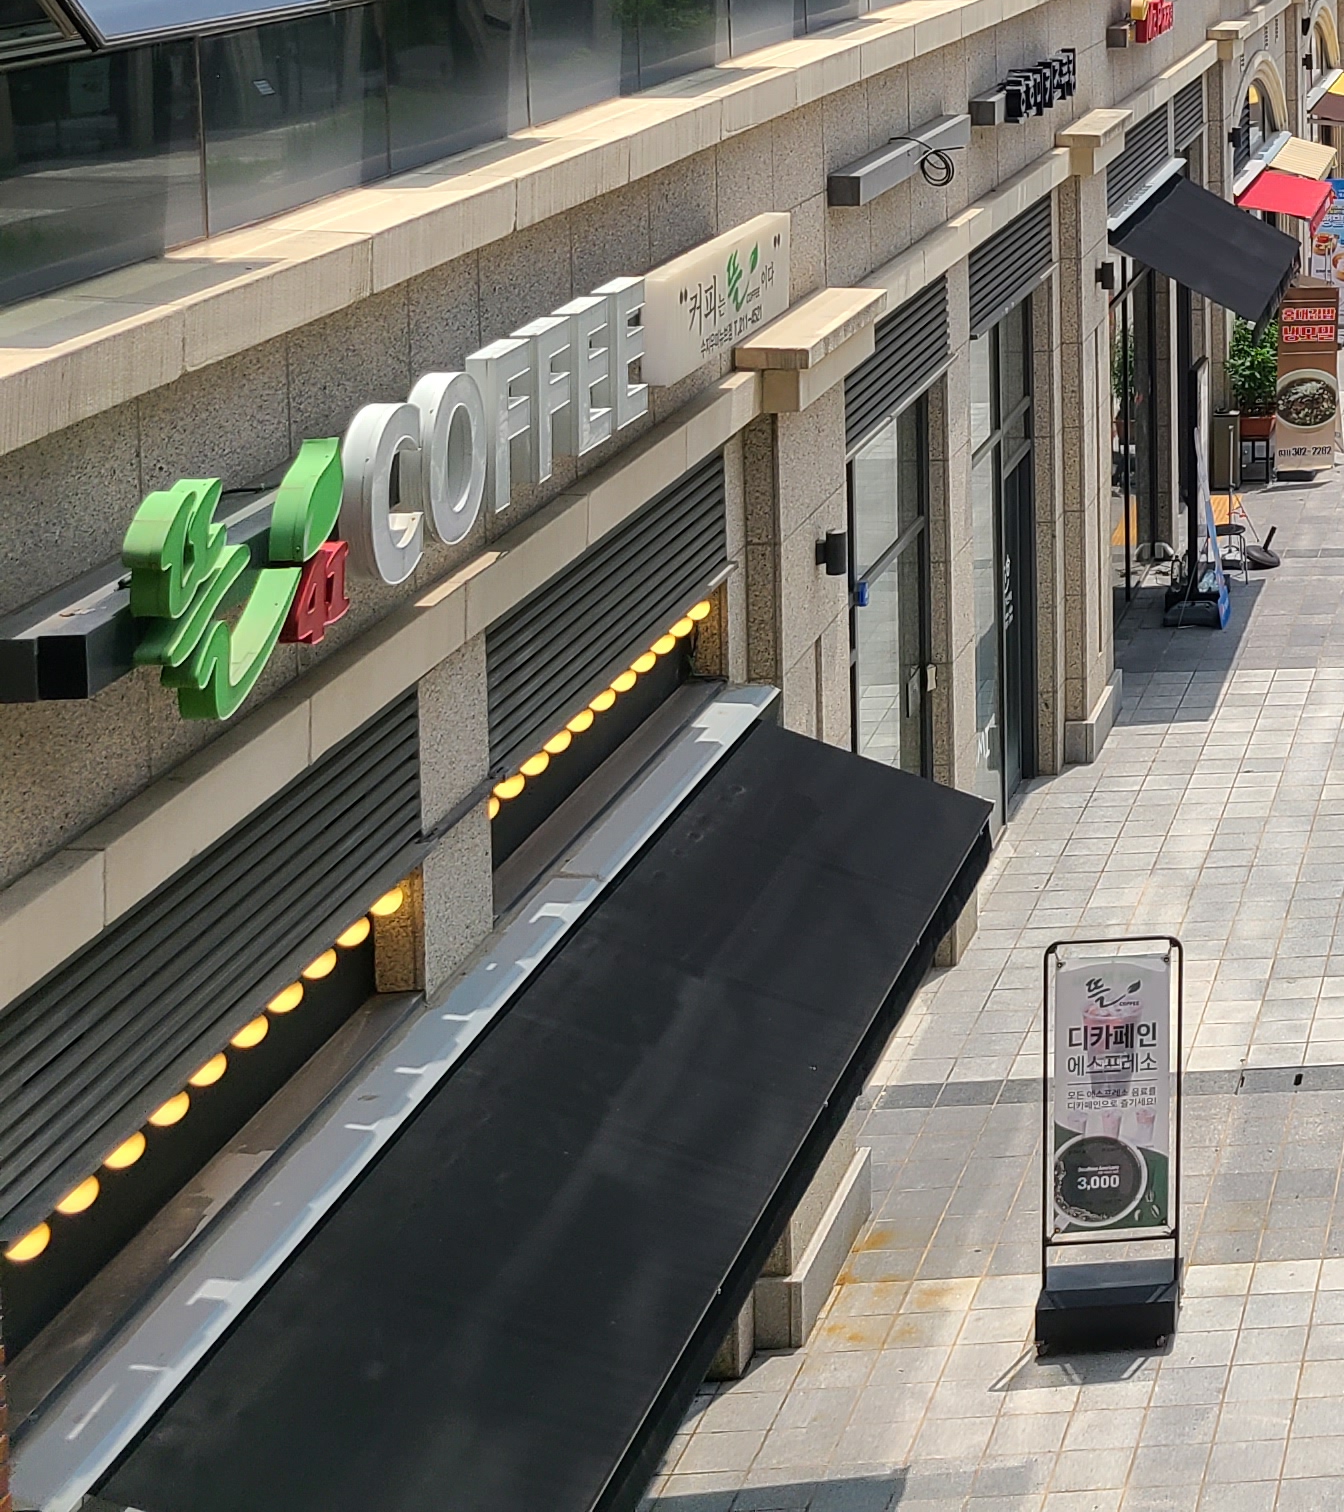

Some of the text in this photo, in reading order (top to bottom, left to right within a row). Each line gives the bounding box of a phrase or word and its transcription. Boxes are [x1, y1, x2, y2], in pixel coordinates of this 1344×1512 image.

[1282, 325, 1336, 343] 냉모밀
[340, 276, 649, 585] COFFEE
[1068, 1022, 1157, 1051] 디카페인
[1067, 1052, 1158, 1077] 에스프레소
[1067, 1096, 1157, 1111] 디카페인으로 즐기세요!
[1077, 1175, 1120, 1191] 3,000
